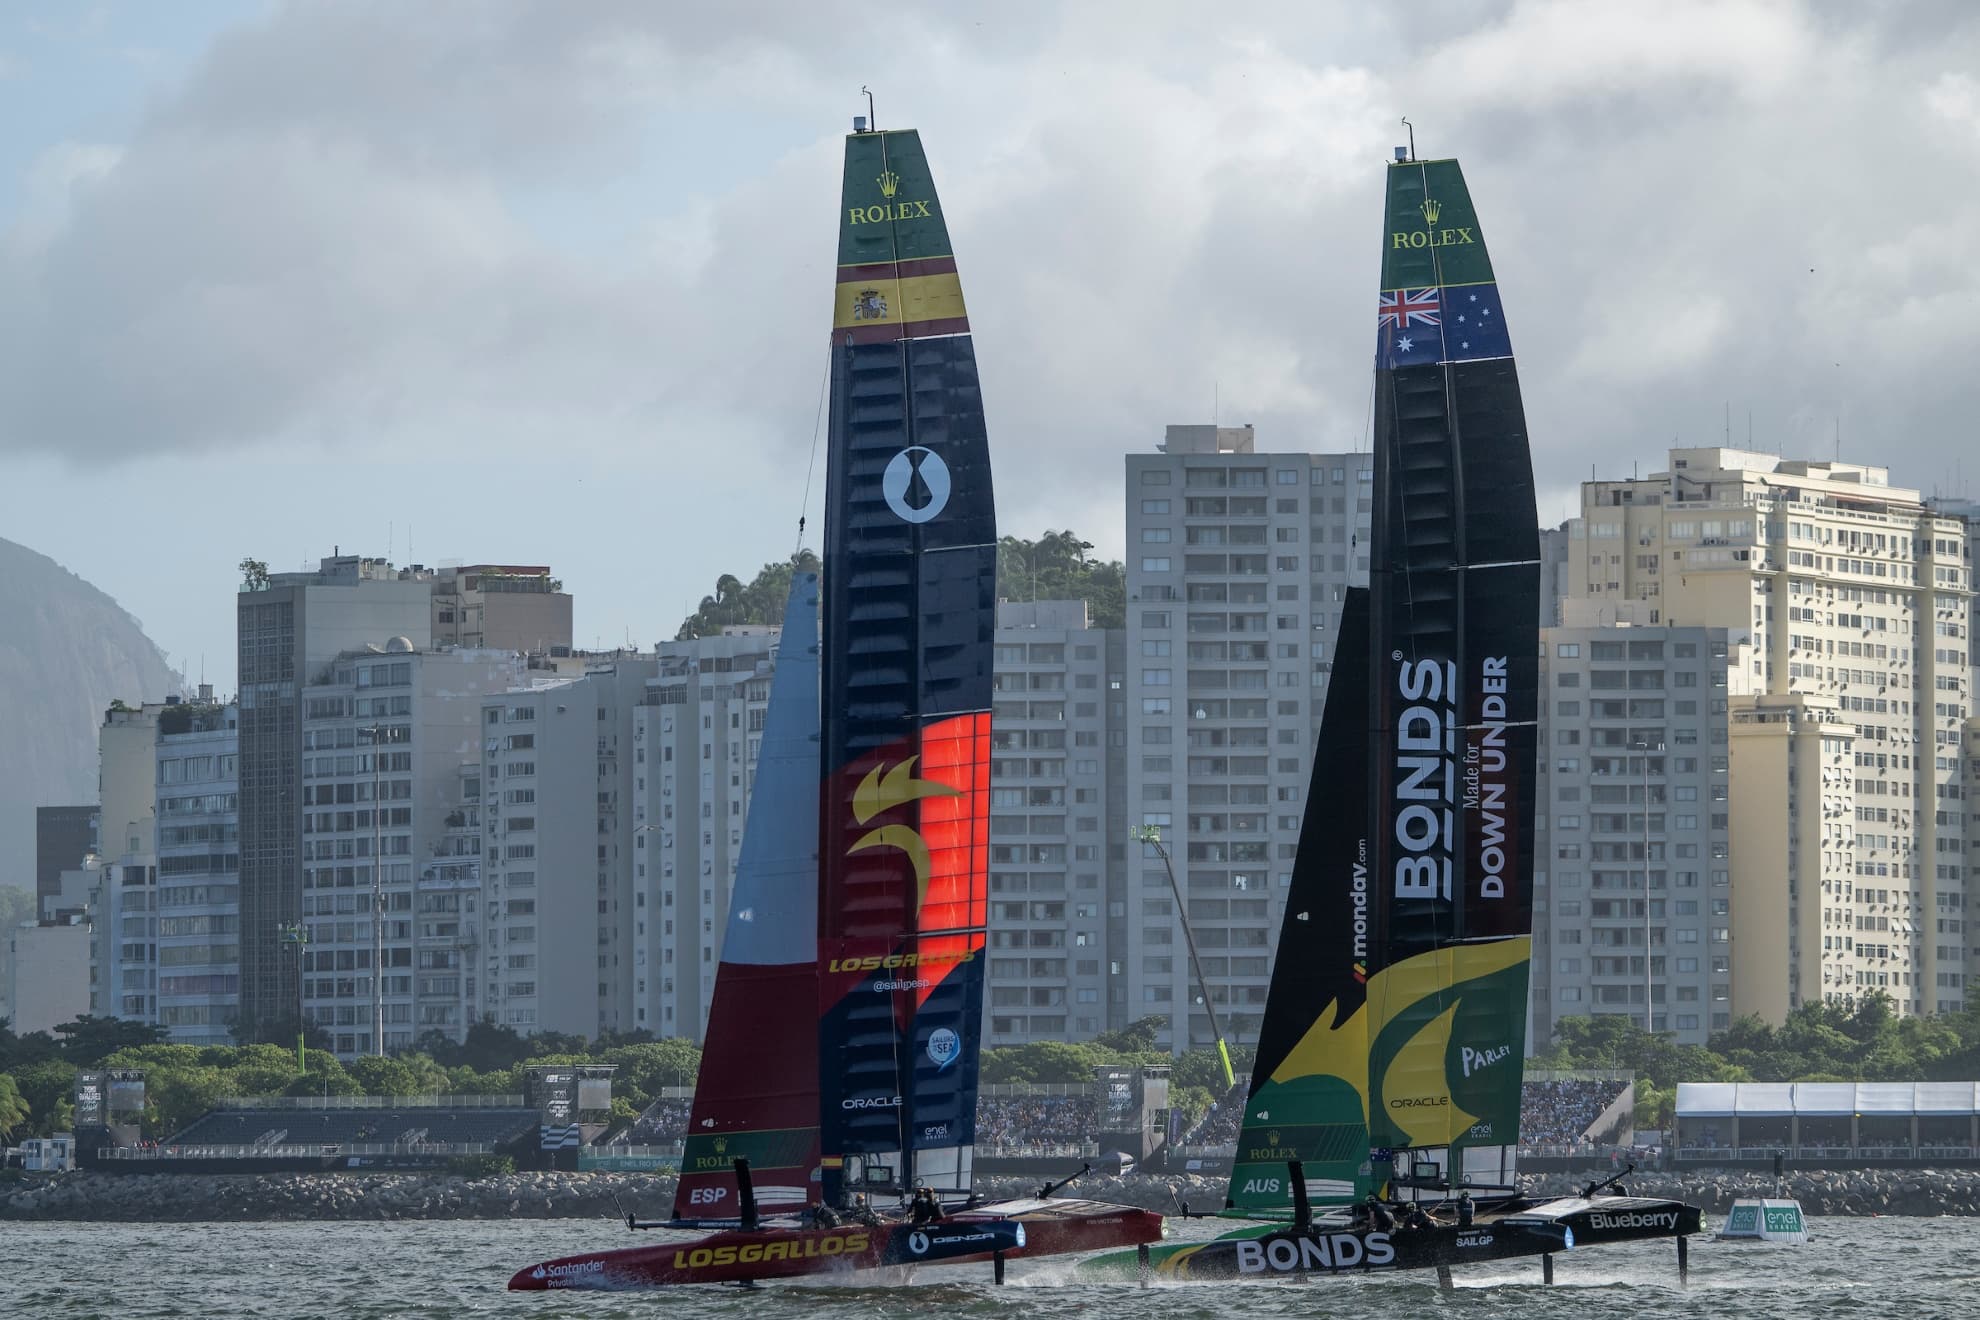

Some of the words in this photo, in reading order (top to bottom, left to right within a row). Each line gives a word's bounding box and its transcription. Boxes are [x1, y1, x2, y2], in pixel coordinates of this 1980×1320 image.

[848, 200, 931, 225] ROLEX
[1392, 227, 1474, 249] ROLEX
[1482, 655, 1507, 772] UNDER
[1463, 743, 1479, 763] for
[1395, 658, 1443, 899] BONDS
[1463, 765, 1479, 810] Made
[1480, 783, 1506, 898] DOWN
[1461, 1045, 1511, 1077] PARLEY
[842, 1096, 903, 1109] ORACLE
[1390, 1096, 1448, 1108] ORACLE
[925, 1123, 947, 1135] enel
[1250, 1147, 1298, 1160] ROLEX
[1243, 1178, 1280, 1193] AUS
[690, 1187, 727, 1204] ESP
[1590, 1212, 1679, 1229] Blueberry
[1767, 1210, 1798, 1224] enel
[933, 1232, 995, 1244] DENZA
[673, 1232, 870, 1269] LOSGALLOS
[1236, 1232, 1396, 1274] BONDS
[548, 1259, 606, 1277] Santander
